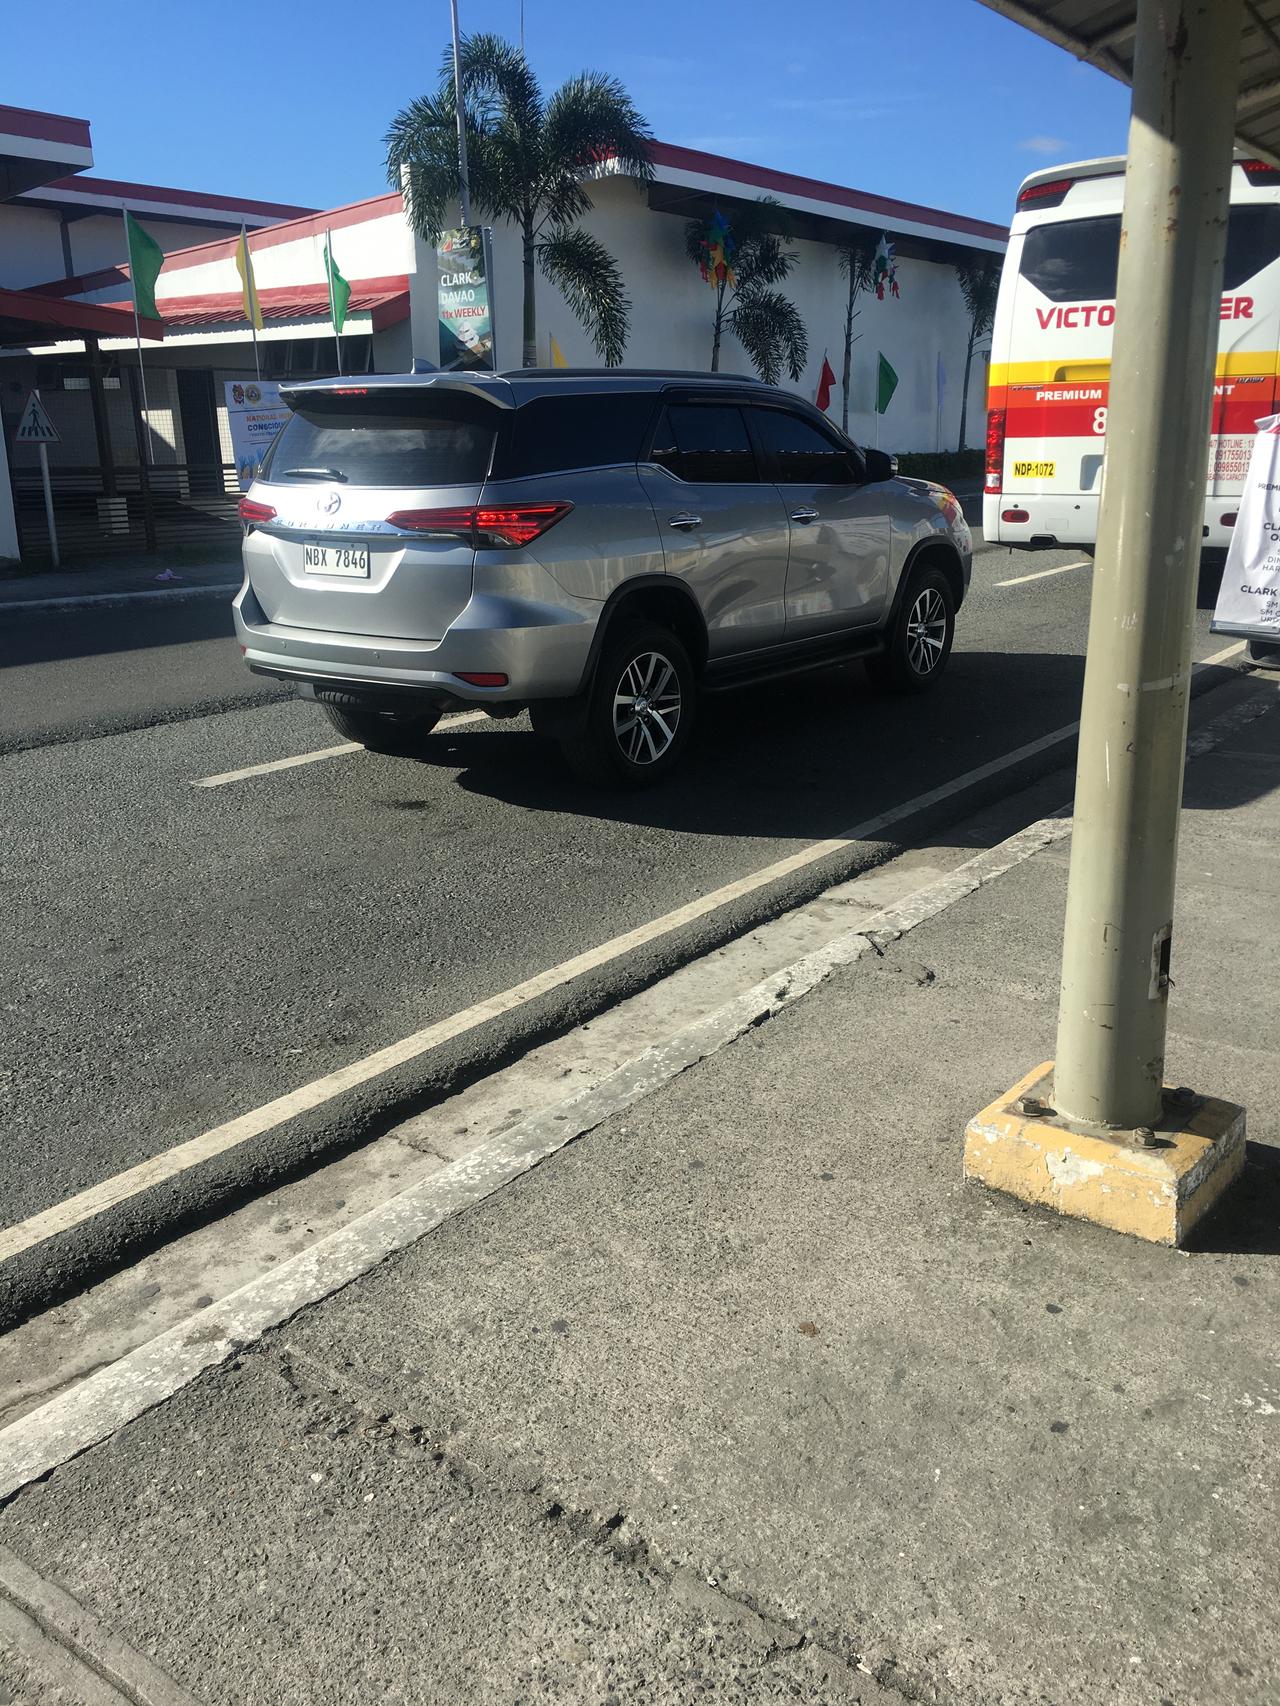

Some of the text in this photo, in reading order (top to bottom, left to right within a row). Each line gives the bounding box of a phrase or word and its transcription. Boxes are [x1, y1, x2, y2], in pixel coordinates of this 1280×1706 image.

[441, 272, 472, 287] CLARK
[440, 290, 475, 304] DAVAO
[454, 306, 486, 318] WEEKLY
[1036, 304, 1116, 330] VICTO
[1036, 389, 1102, 401] PREMIUM
[1014, 463, 1055, 476] NDP-1072
[305, 547, 366, 569] NBX 7846
[1240, 584, 1278, 597] CLARK
[1266, 600, 1278, 608] SM
